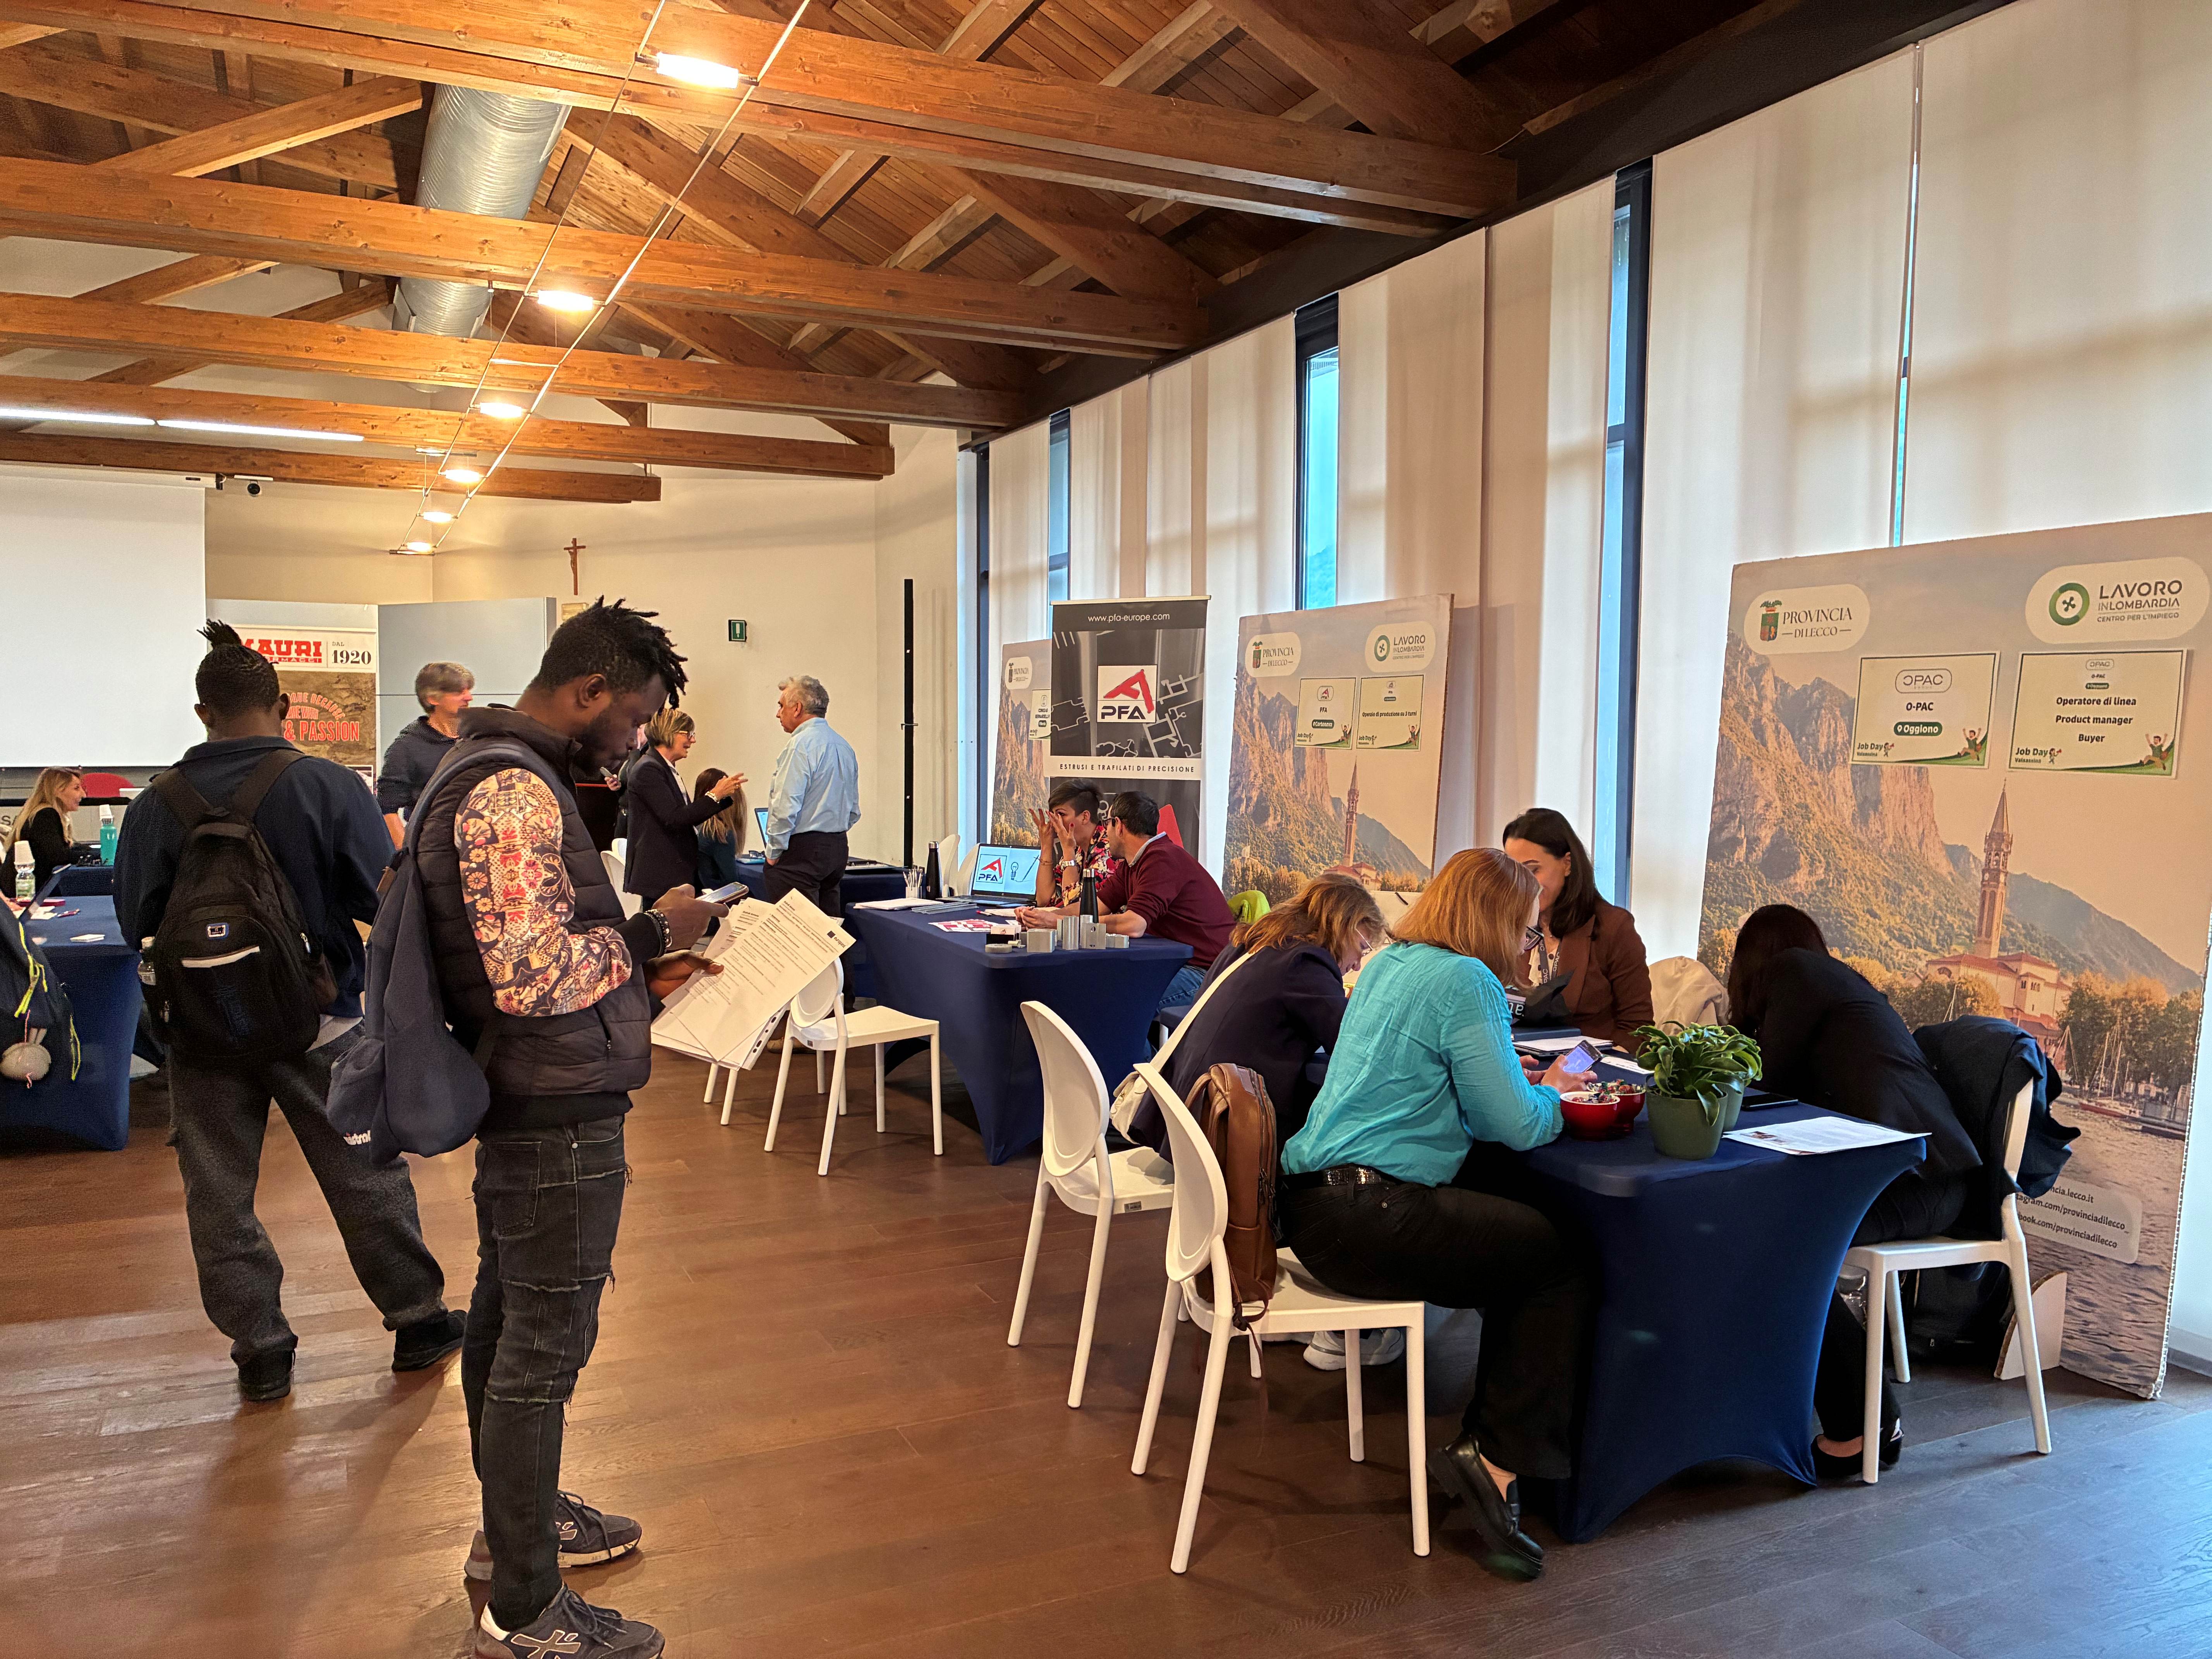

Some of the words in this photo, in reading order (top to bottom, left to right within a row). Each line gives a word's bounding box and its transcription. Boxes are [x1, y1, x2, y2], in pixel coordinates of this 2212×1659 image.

[2099, 580, 2183, 599] LAVORO
[1088, 613, 1170, 623] www.pfa-europe.com
[1783, 607, 1852, 624] PROVINCIA
[2143, 612, 2179, 620] L'IMPIEGO
[1394, 635, 1425, 646] LAVORO
[242, 639, 322, 657] AURI
[1263, 647, 1293, 658] PROVINCIA
[332, 649, 372, 665] 1920
[1906, 702, 1934, 711] O-PAC
[2056, 697, 2101, 706] Operatore
[2103, 697, 2111, 705] di
[2114, 697, 2136, 705] linea
[1101, 705, 1146, 720] PFA
[2056, 715, 2091, 723] Product
[2092, 716, 2133, 725] manager
[284, 720, 296, 741] &
[299, 720, 359, 741] PASSION
[1903, 725, 1939, 734] Oggiono
[2078, 734, 2105, 743] Buyer
[1870, 743, 1883, 751] Day
[2015, 747, 2030, 756] Job
[2032, 748, 2048, 757] Day
[979, 873, 998, 882] PFA
[2051, 1186, 2094, 1204] ncia.lecco.it
[2016, 1193, 2130, 1234] tagram.com/provinciadilecco_
[2018, 1211, 2118, 1249] book.com/provinciadilecco
